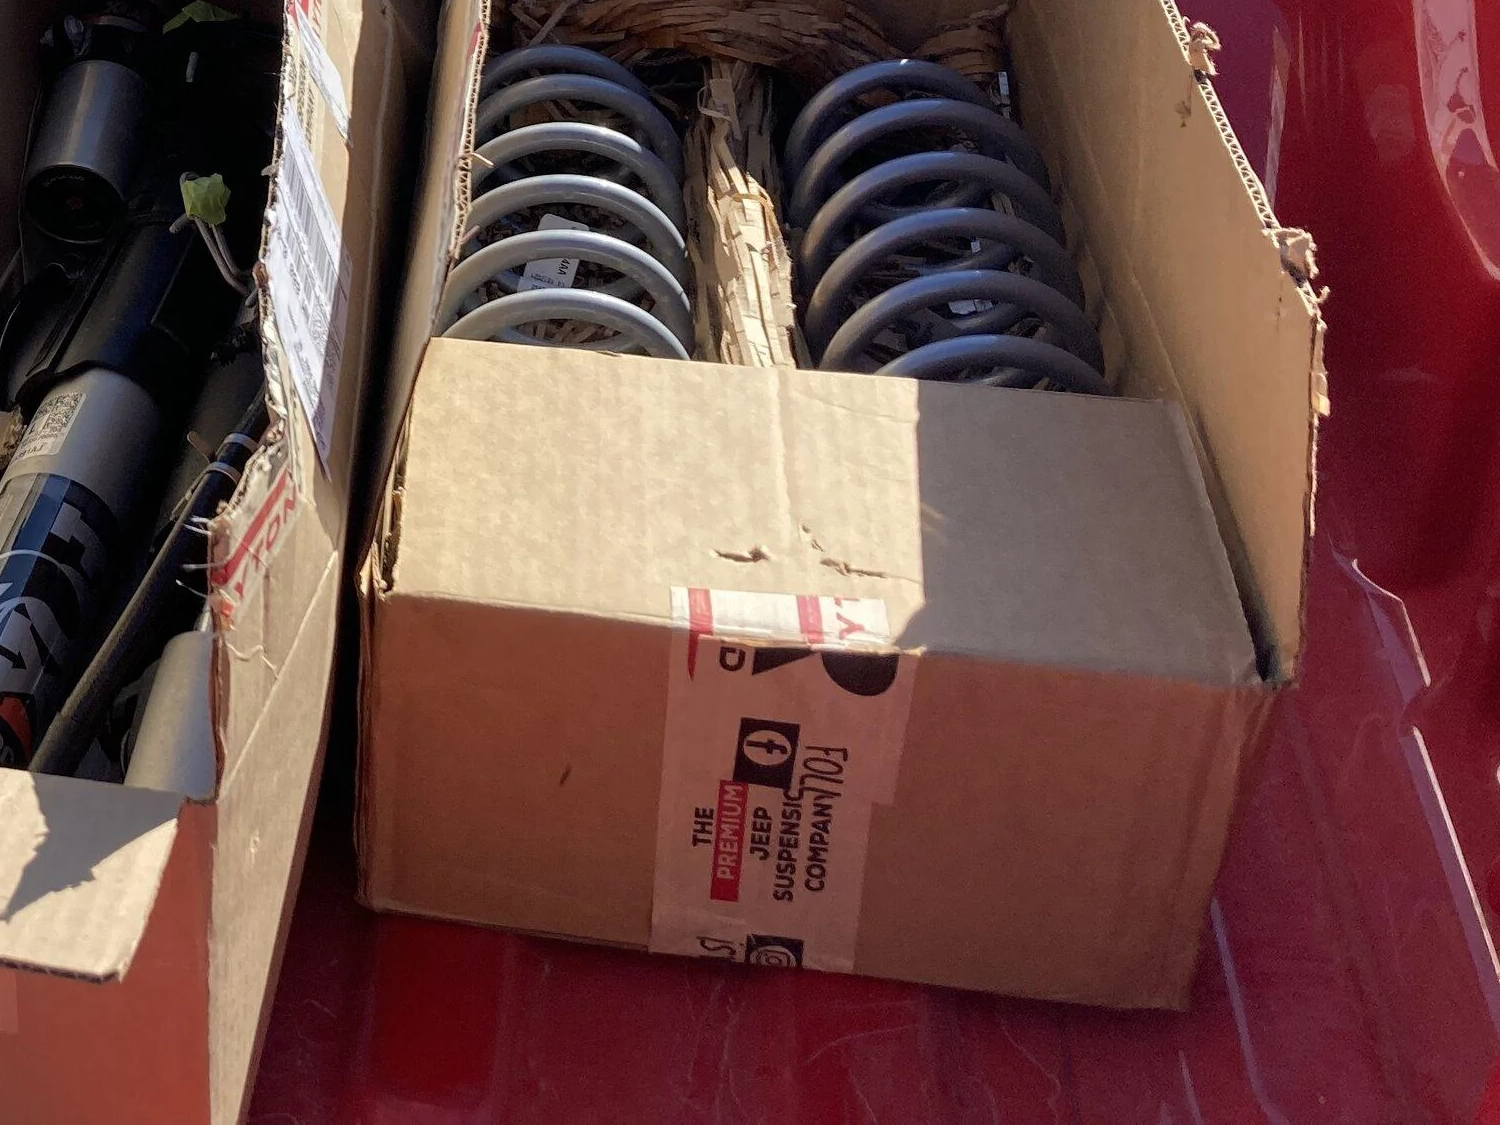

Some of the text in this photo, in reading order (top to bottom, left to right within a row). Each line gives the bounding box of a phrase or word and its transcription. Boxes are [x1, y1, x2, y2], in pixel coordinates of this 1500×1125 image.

[692, 807, 714, 848] THE
[716, 784, 744, 880] PREMIUM
[750, 806, 773, 862] JEEP
